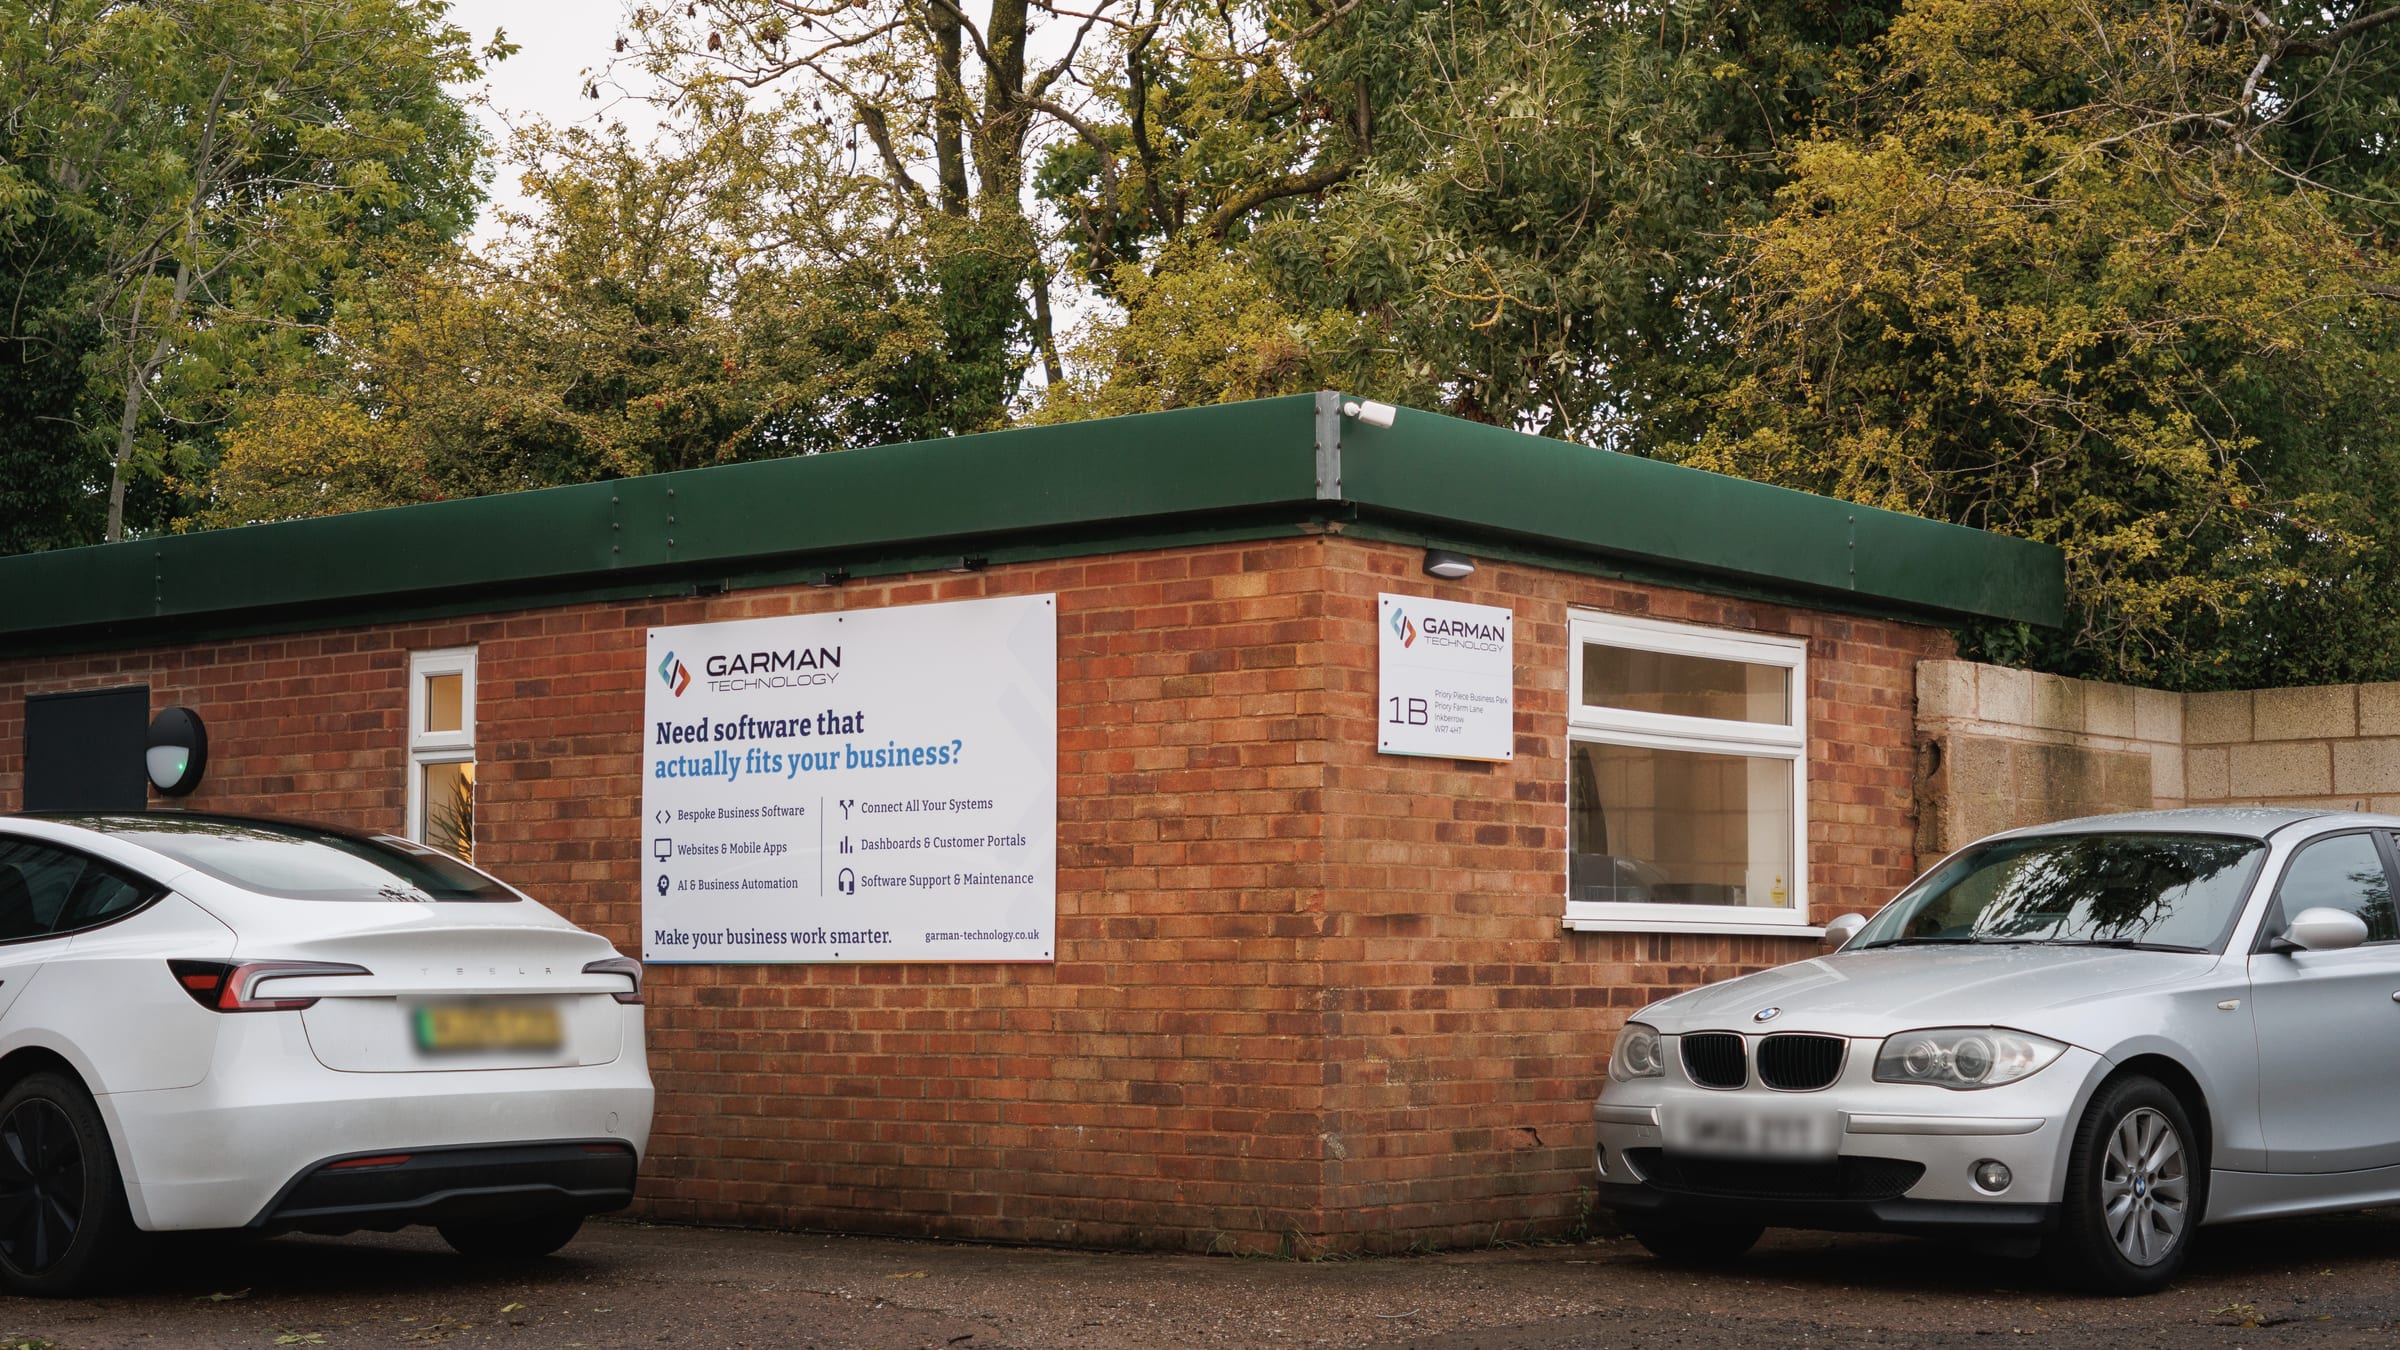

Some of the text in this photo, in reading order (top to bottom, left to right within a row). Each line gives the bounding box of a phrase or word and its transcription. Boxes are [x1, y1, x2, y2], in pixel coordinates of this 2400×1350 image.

[1423, 617, 1505, 643] GARMAN
[1424, 635, 1504, 653] TECHNOLOGY
[706, 646, 841, 677] GARMAN
[707, 672, 839, 693] TECHNOLOGY
[1389, 696, 1428, 726] 1B
[656, 709, 865, 745] Need software that
[655, 739, 963, 782] actually fits your business?
[677, 804, 805, 823] Bespoke Business Software
[861, 798, 993, 814] Connect All Your Systems
[677, 841, 787, 856] Websites & Mobile Apps
[861, 833, 1026, 851] Dashboards & Customer Portals
[677, 877, 798, 891] AI & Business Automation
[861, 872, 1034, 889] Software Support & Maintenance
[654, 927, 892, 949] Make your business work smarter.
[925, 928, 1040, 944] garman-technology.co.uk
[420, 966, 552, 976] TESLA
